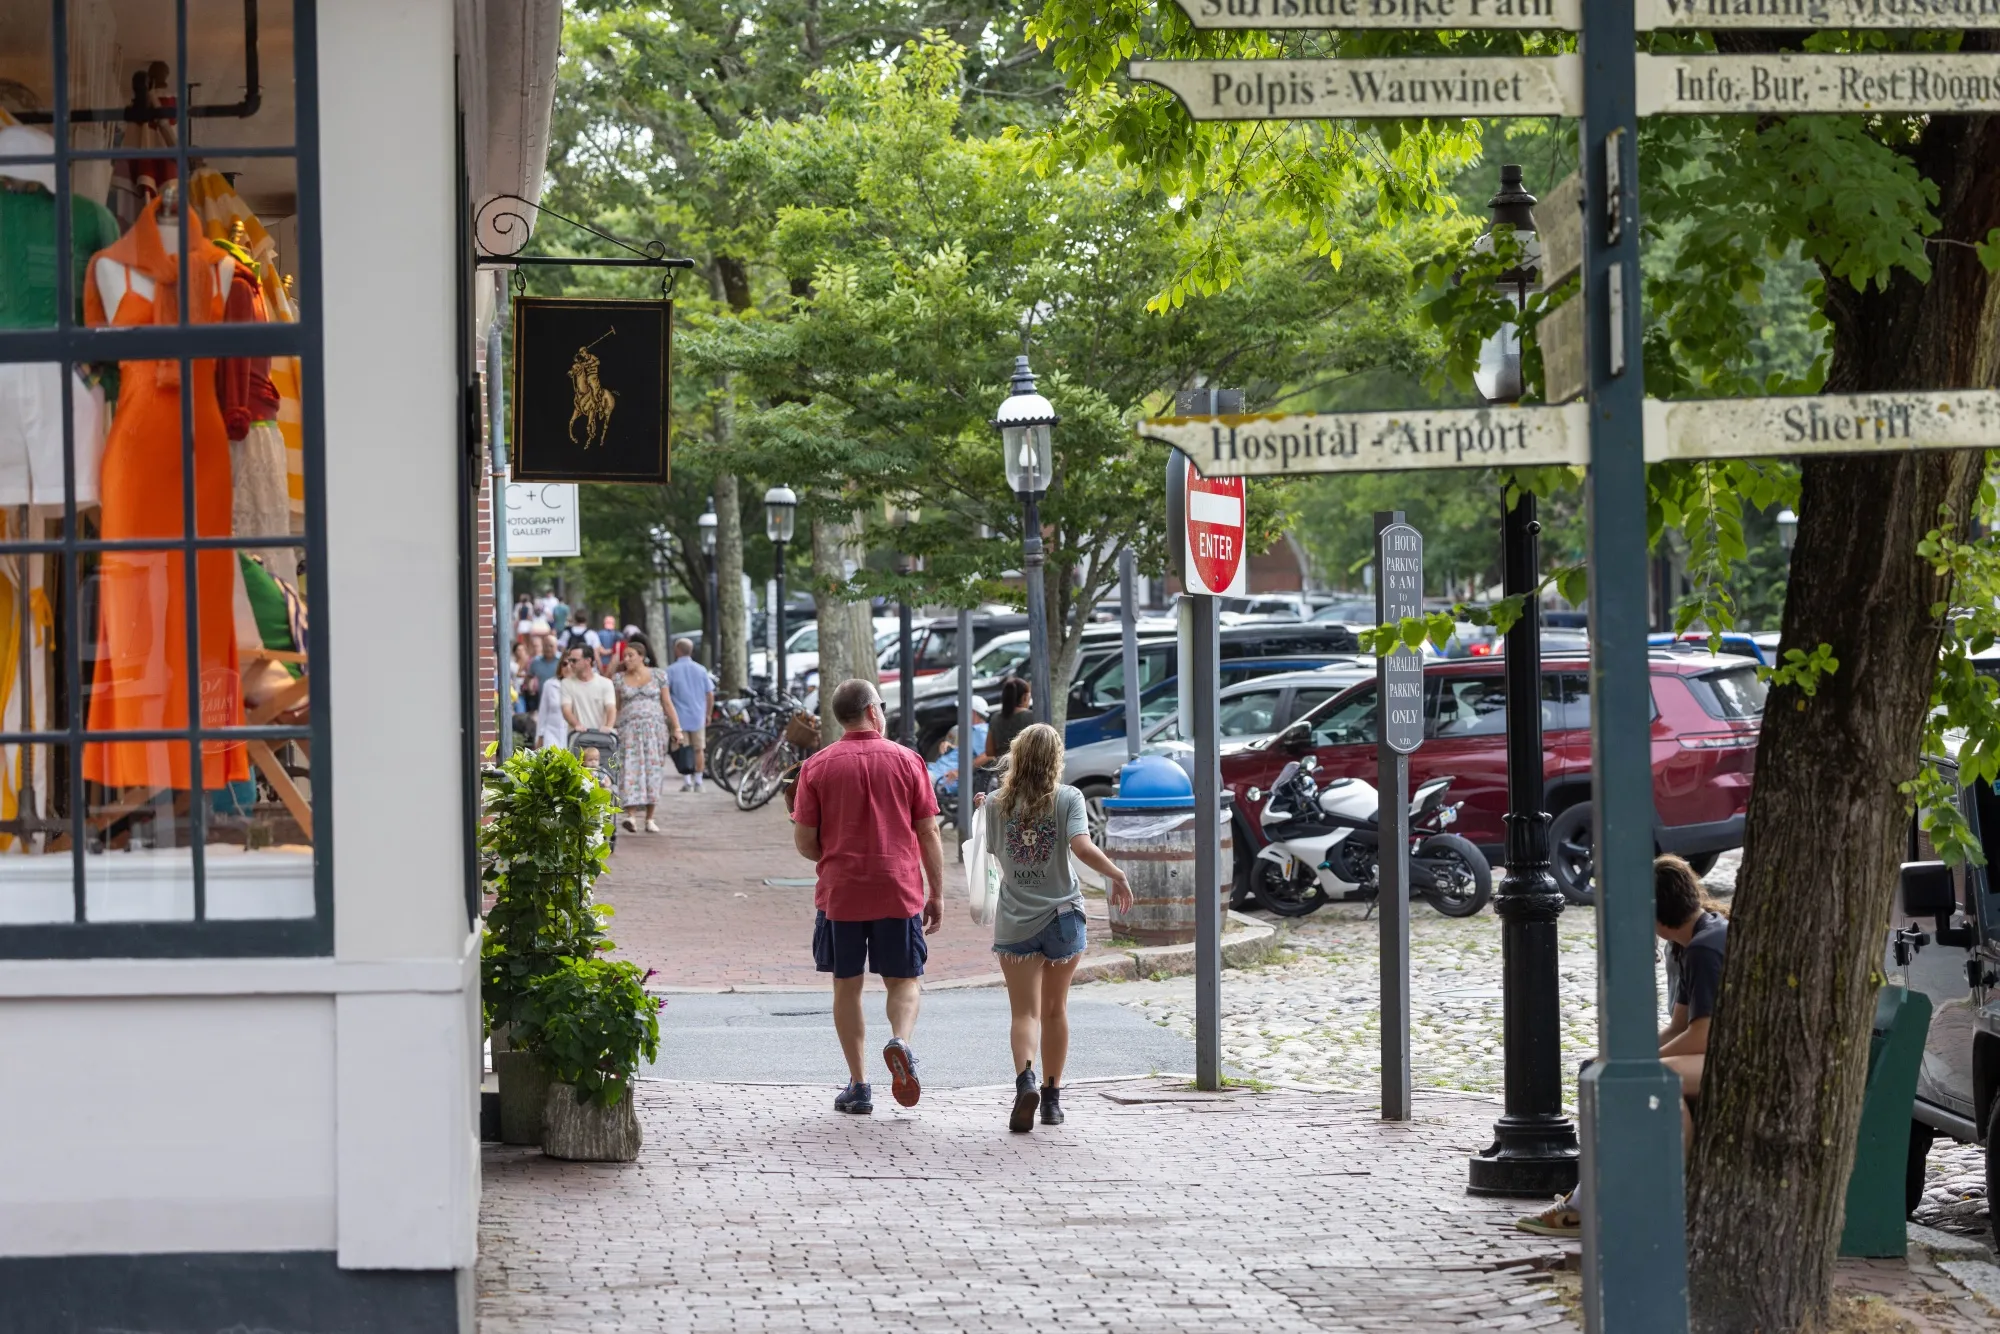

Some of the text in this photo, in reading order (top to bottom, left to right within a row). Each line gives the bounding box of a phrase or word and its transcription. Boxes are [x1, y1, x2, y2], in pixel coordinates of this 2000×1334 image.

[1676, 66, 1741, 102] Info.
[1839, 65, 1900, 102] Rest
[1907, 65, 2000, 102] Rooms
[1212, 72, 1315, 114] Polpis
[1349, 69, 1522, 103] Wauwinet
[1784, 401, 1914, 443] Sheriff
[1212, 422, 1358, 468] Hospital
[1394, 418, 1526, 462] Airport
[541, 483, 561, 509] C
[512, 527, 552, 536] GALLERY
[1200, 532, 1233, 561] ENTER
[1394, 535, 1417, 551] HOUR
[1386, 557, 1419, 572] PARKING
[1390, 574, 1415, 589] 8 AM
[1398, 593, 1408, 602] TO
[1390, 604, 1415, 619] 7 PM
[1388, 656, 1420, 672] PARALLEL
[1389, 683, 1420, 698] PARKING
[1392, 709, 1418, 724] ONLY
[1014, 870, 1046, 879] KONA
